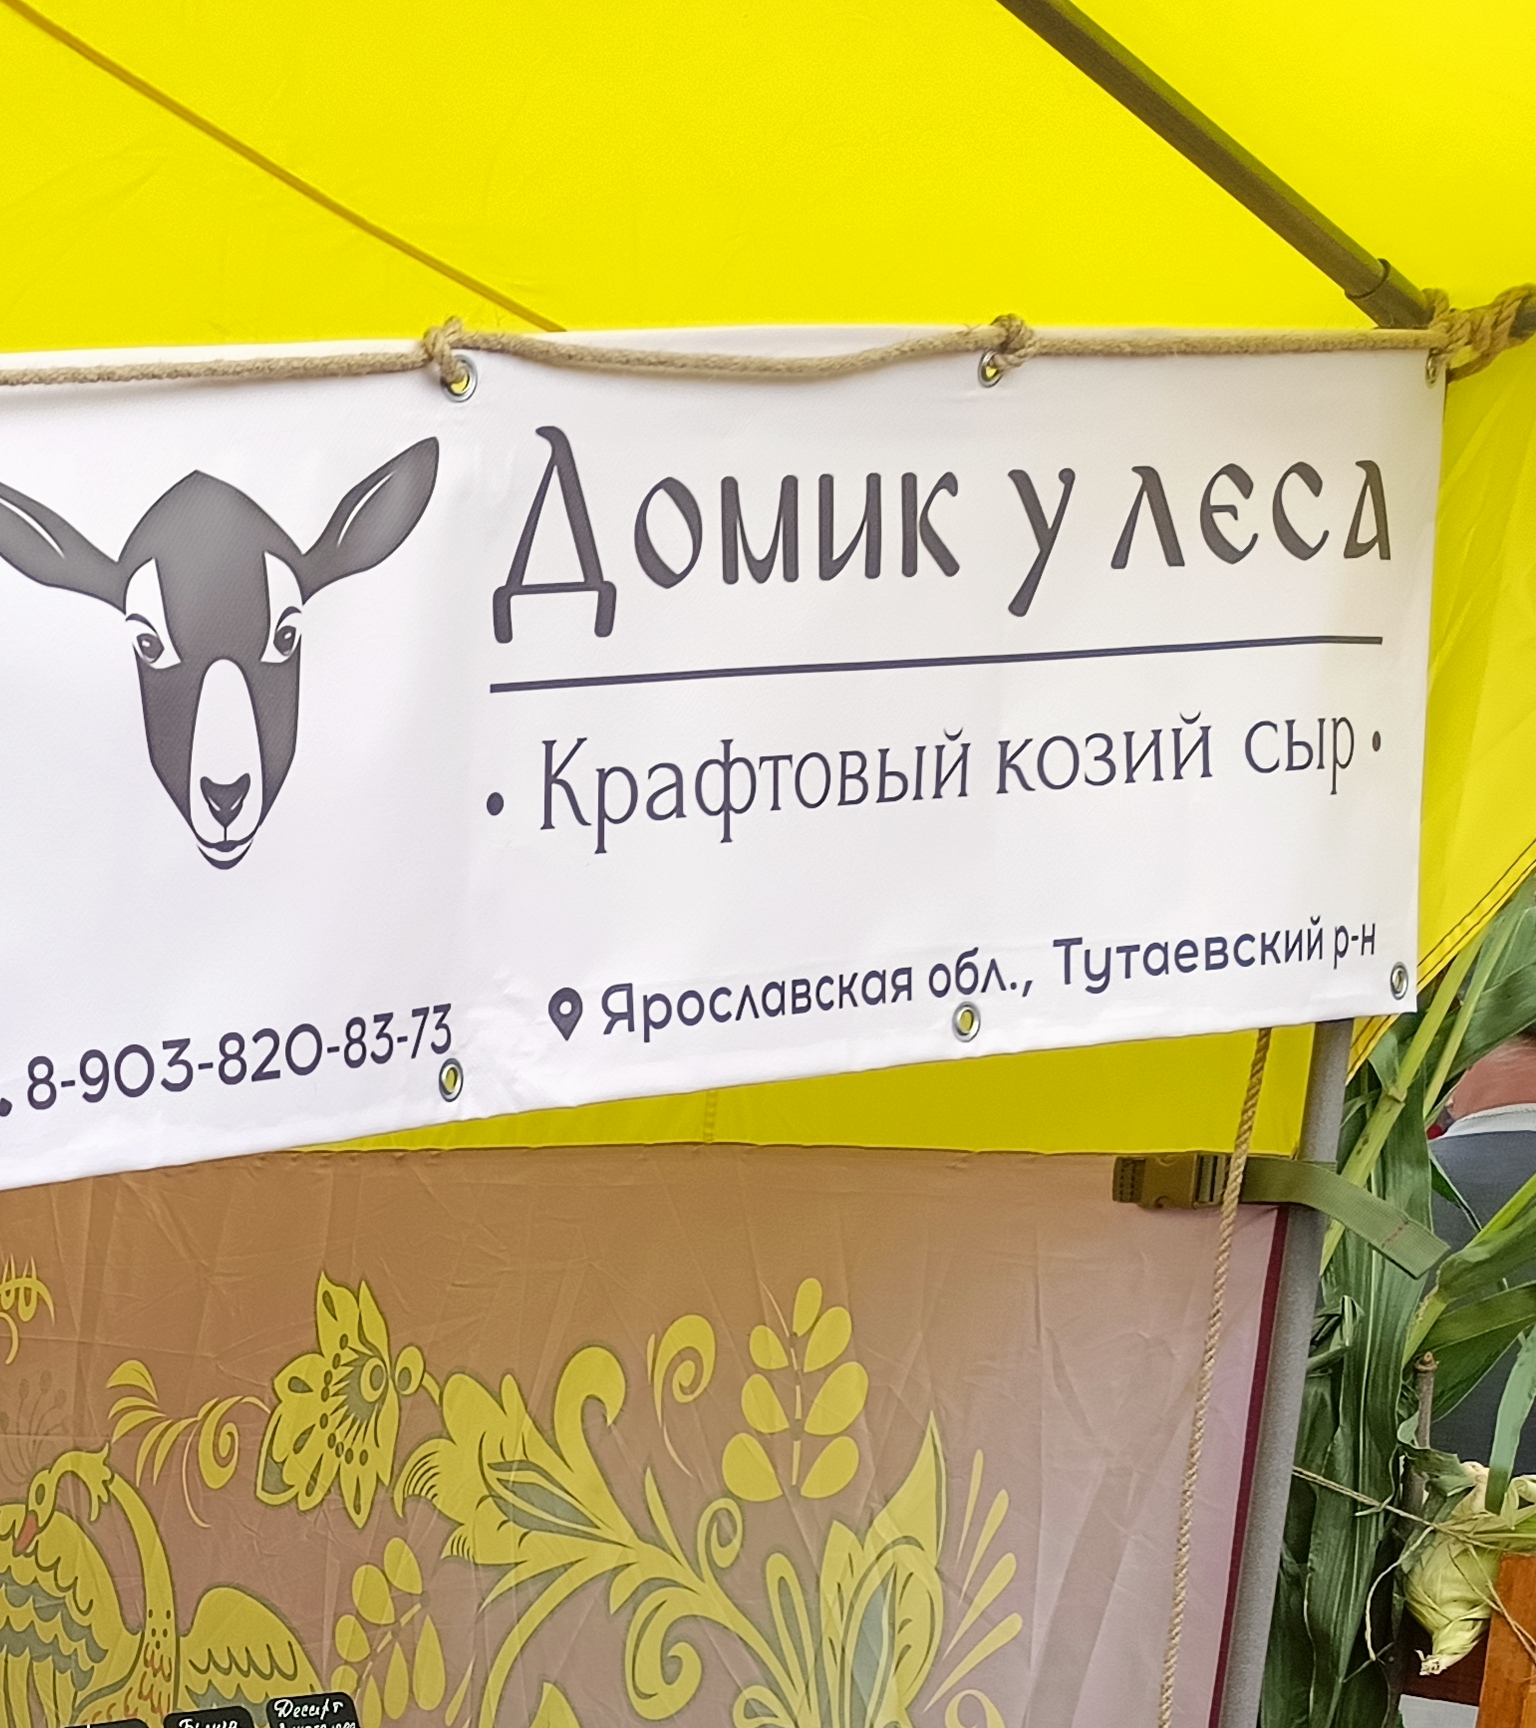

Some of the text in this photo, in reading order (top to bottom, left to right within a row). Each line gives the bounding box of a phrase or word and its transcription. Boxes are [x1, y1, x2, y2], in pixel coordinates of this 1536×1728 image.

[492, 425, 960, 644] Домик
[1007, 467, 1076, 617] у
[540, 712, 1355, 855] Крафтовый козий сыр
[601, 916, 1376, 1043] Ярославская обл., Тутаевский р-н
[27, 1003, 453, 1110] 8-903-820-83-73
